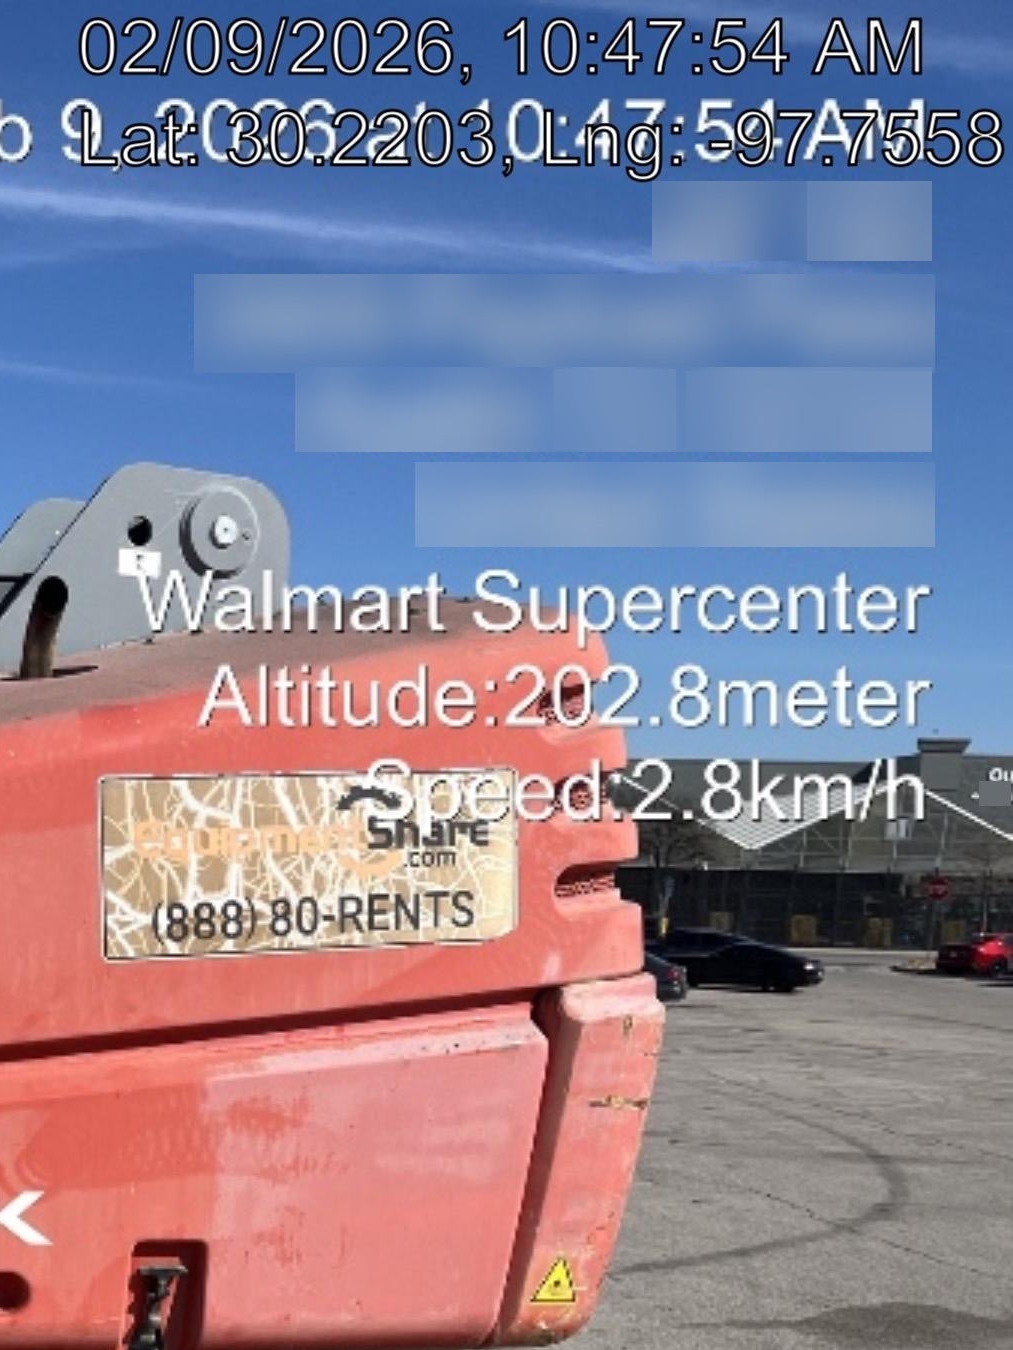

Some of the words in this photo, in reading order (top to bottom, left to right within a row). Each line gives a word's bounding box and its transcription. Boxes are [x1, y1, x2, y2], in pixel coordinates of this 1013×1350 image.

[403, 849, 457, 868] .com
[152, 898, 257, 945] (888)
[269, 890, 476, 937] 80-RENTS
